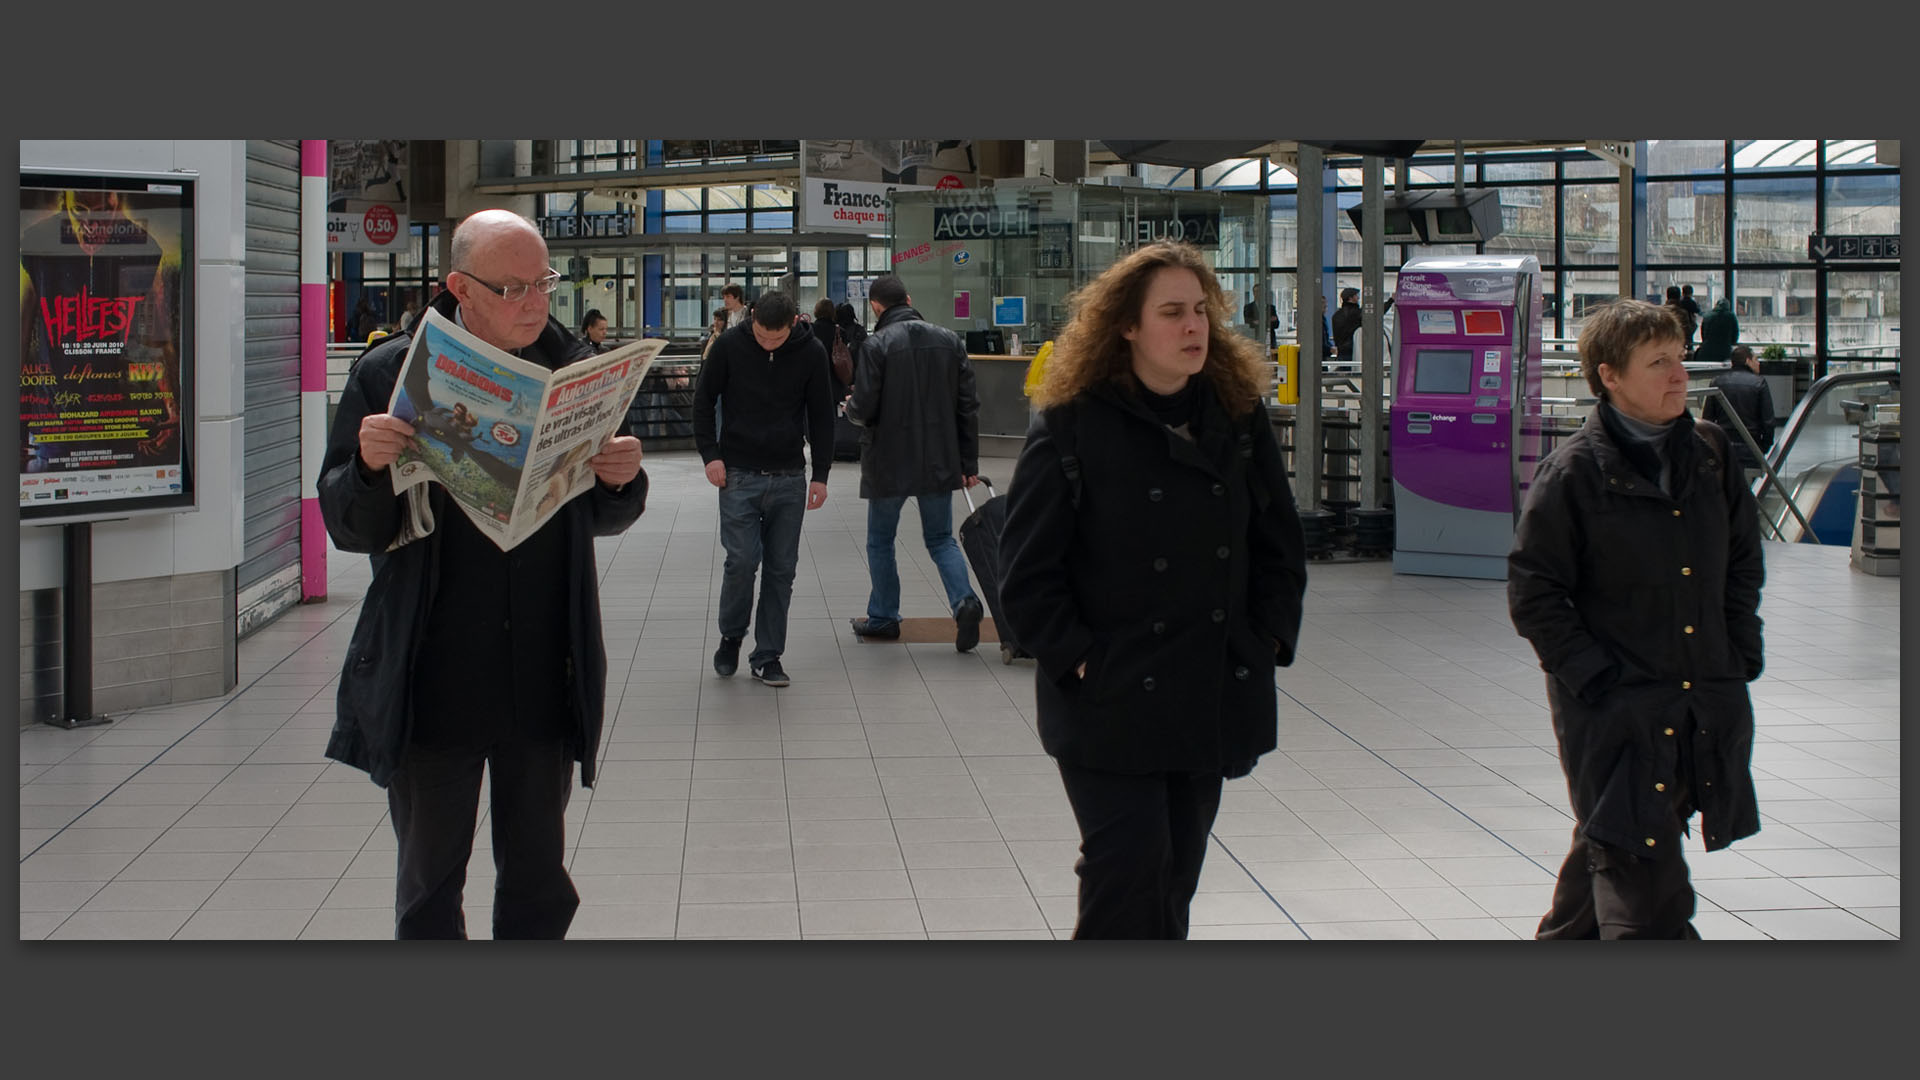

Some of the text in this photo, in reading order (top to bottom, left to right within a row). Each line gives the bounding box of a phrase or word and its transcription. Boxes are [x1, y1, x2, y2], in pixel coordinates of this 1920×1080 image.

[833, 208, 874, 224] chaque
[934, 210, 1038, 238] ACCUEIL
[891, 242, 931, 265] RENNES
[1866, 245, 1875, 255] 4
[1890, 244, 1900, 255] 3
[40, 284, 145, 348] HELLFEST
[21, 364, 52, 375] ALICE
[63, 363, 122, 384] deftones
[435, 353, 514, 402] DRAGONS
[59, 411, 99, 419] BIOHAZARD
[139, 408, 162, 416] SAXON
[540, 400, 604, 435] Le vrai visage
[1432, 414, 1456, 423] échange
[536, 406, 615, 452] des ultras du foot
